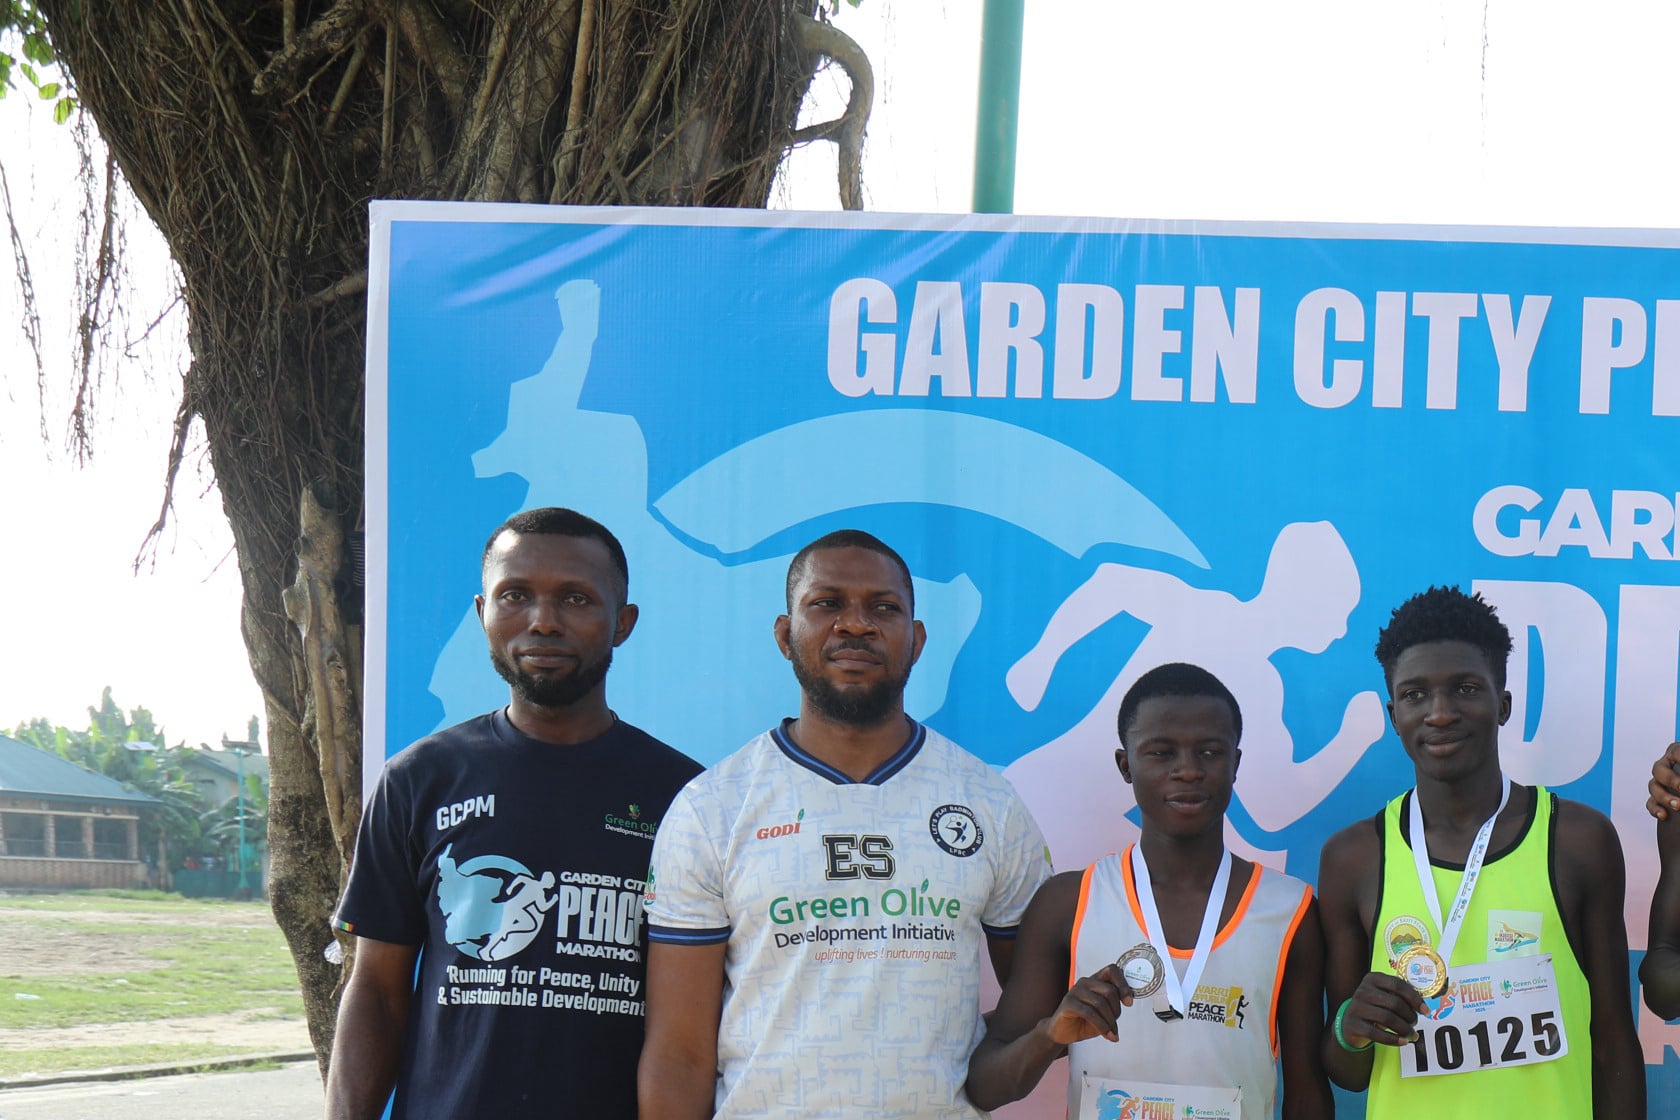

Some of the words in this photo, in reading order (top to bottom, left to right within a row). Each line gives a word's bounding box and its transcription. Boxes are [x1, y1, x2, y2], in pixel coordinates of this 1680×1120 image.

[827, 276, 1260, 404] GARDEN
[1293, 287, 1552, 412] CITY
[436, 794, 496, 831] GCPM
[605, 813, 638, 830] Green
[641, 821, 657, 834] Oli
[605, 823, 644, 839] Development
[756, 821, 801, 840] GODI
[822, 834, 896, 881] ES
[560, 871, 621, 888] GARDEN
[769, 896, 870, 926] Green
[881, 886, 961, 919] Olive
[774, 925, 887, 949] Development
[815, 948, 854, 963] uplifting
[857, 948, 878, 960] lives
[886, 949, 930, 963] nurturing
[511, 965, 536, 985] for
[539, 968, 595, 993] Peace,
[599, 972, 640, 998] Unity
[1460, 981, 1494, 1003] PEACE
[437, 987, 449, 1006] &
[450, 986, 538, 1008] Sustainable
[542, 990, 647, 1018] Development
[1189, 1001, 1225, 1016] PEACE
[1462, 1001, 1495, 1009] MARATHON
[1188, 1012, 1225, 1023] MARATHON
[1410, 1010, 1562, 1072] 10125
[1195, 1108, 1214, 1116] Green
